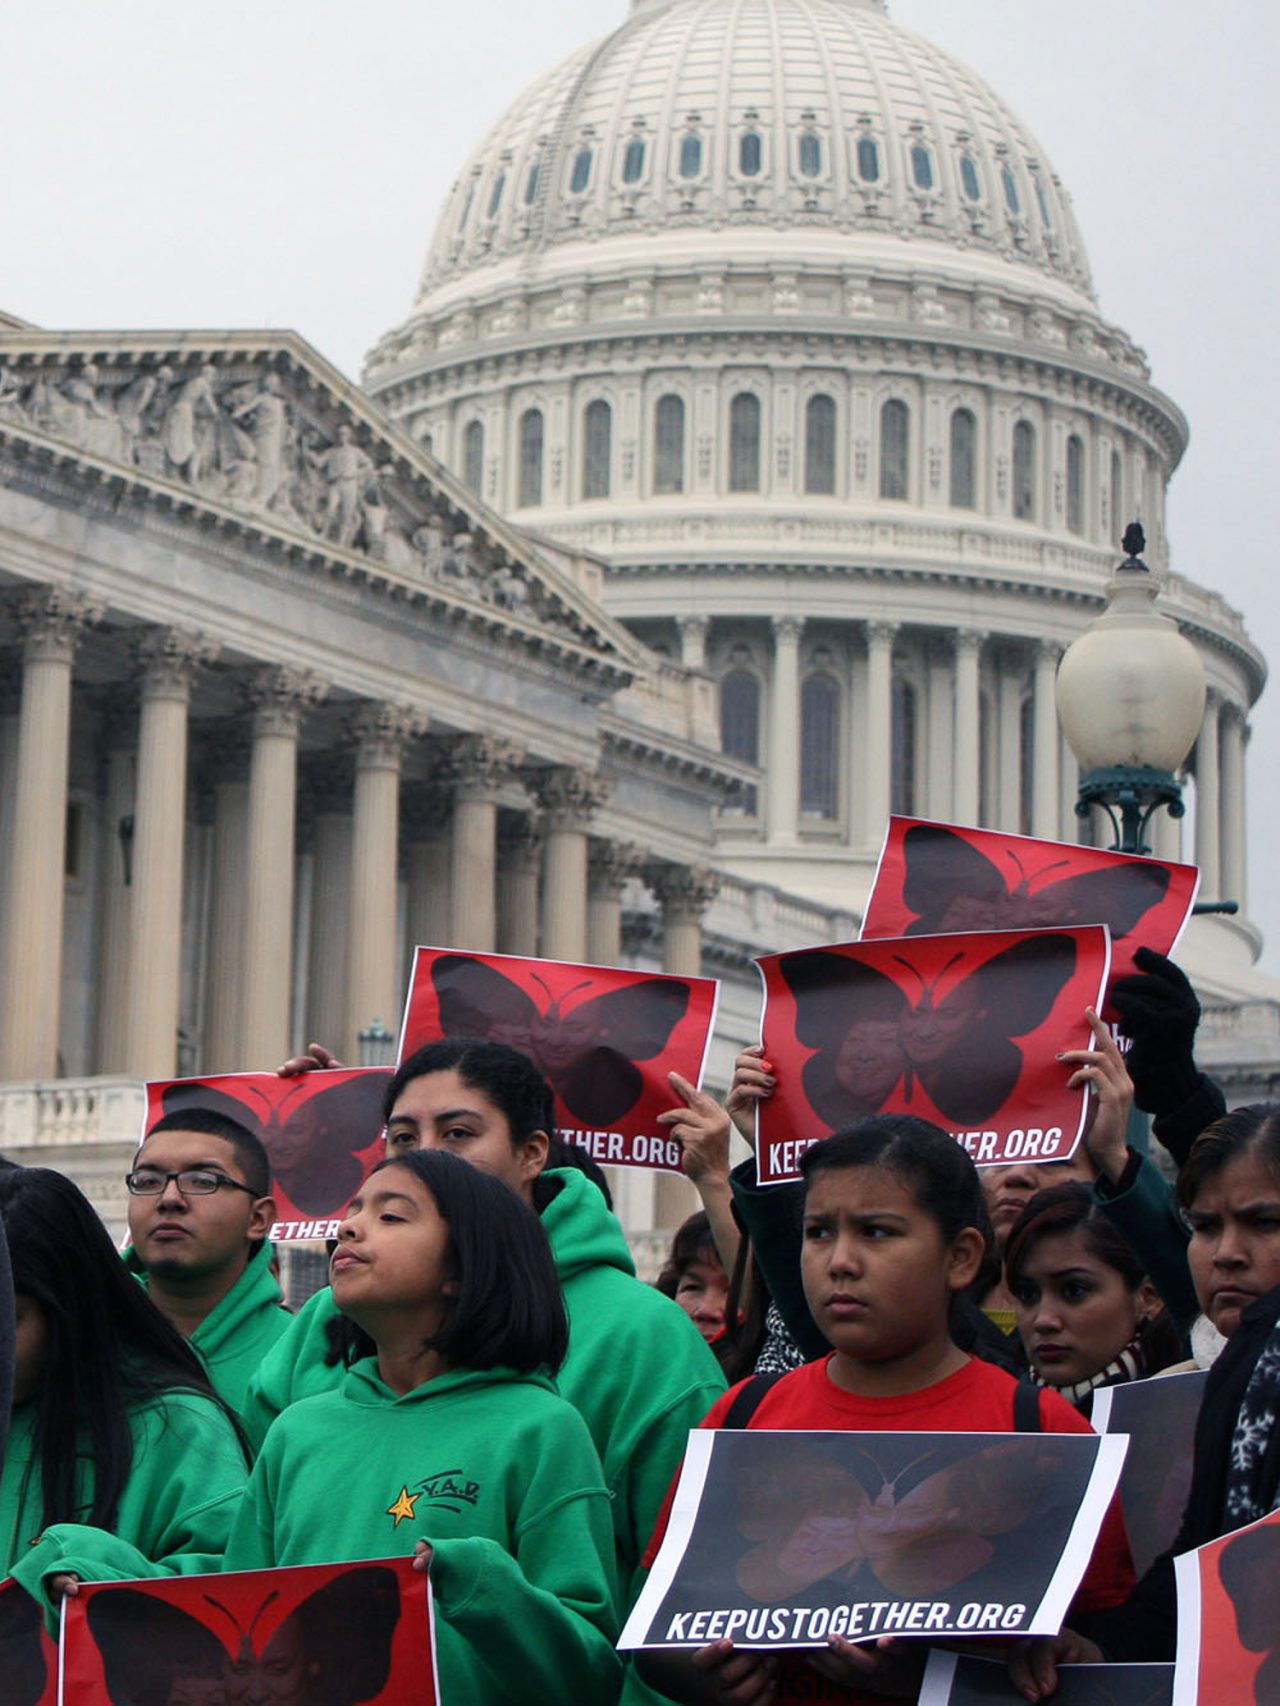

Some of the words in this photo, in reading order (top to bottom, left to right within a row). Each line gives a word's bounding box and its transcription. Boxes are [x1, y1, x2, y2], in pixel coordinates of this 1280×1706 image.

[552, 1127, 679, 1166] THER.ORG
[948, 1127, 1062, 1160] ER.ORG
[665, 1602, 1026, 1641] KEEPUSTOGETHER.ORG
